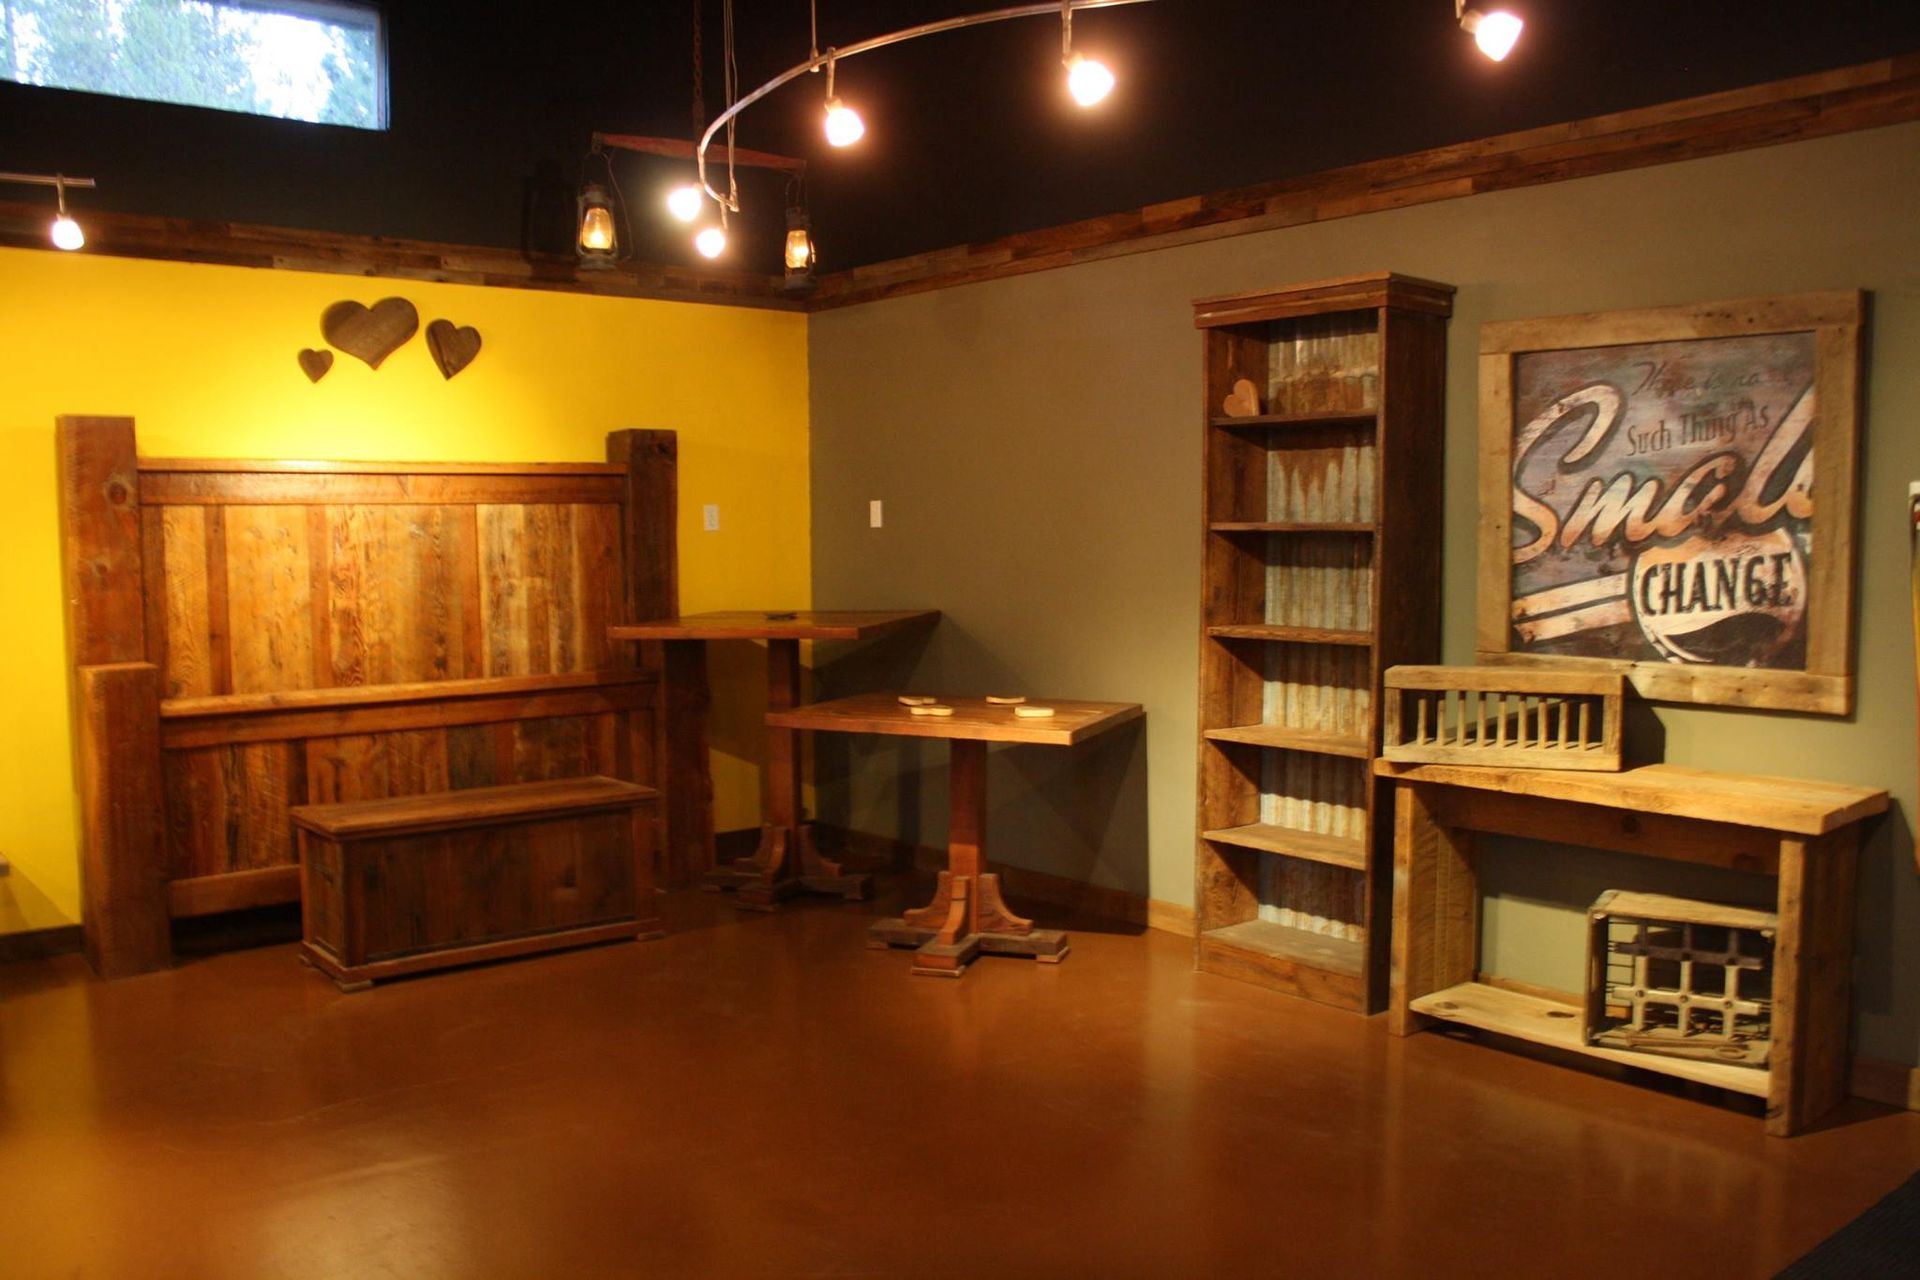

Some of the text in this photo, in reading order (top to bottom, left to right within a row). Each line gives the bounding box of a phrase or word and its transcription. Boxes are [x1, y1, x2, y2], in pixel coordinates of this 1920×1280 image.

[1626, 419, 1672, 457] Such
[1679, 408, 1738, 446] Thing
[1639, 551, 1793, 618] CHANGE
